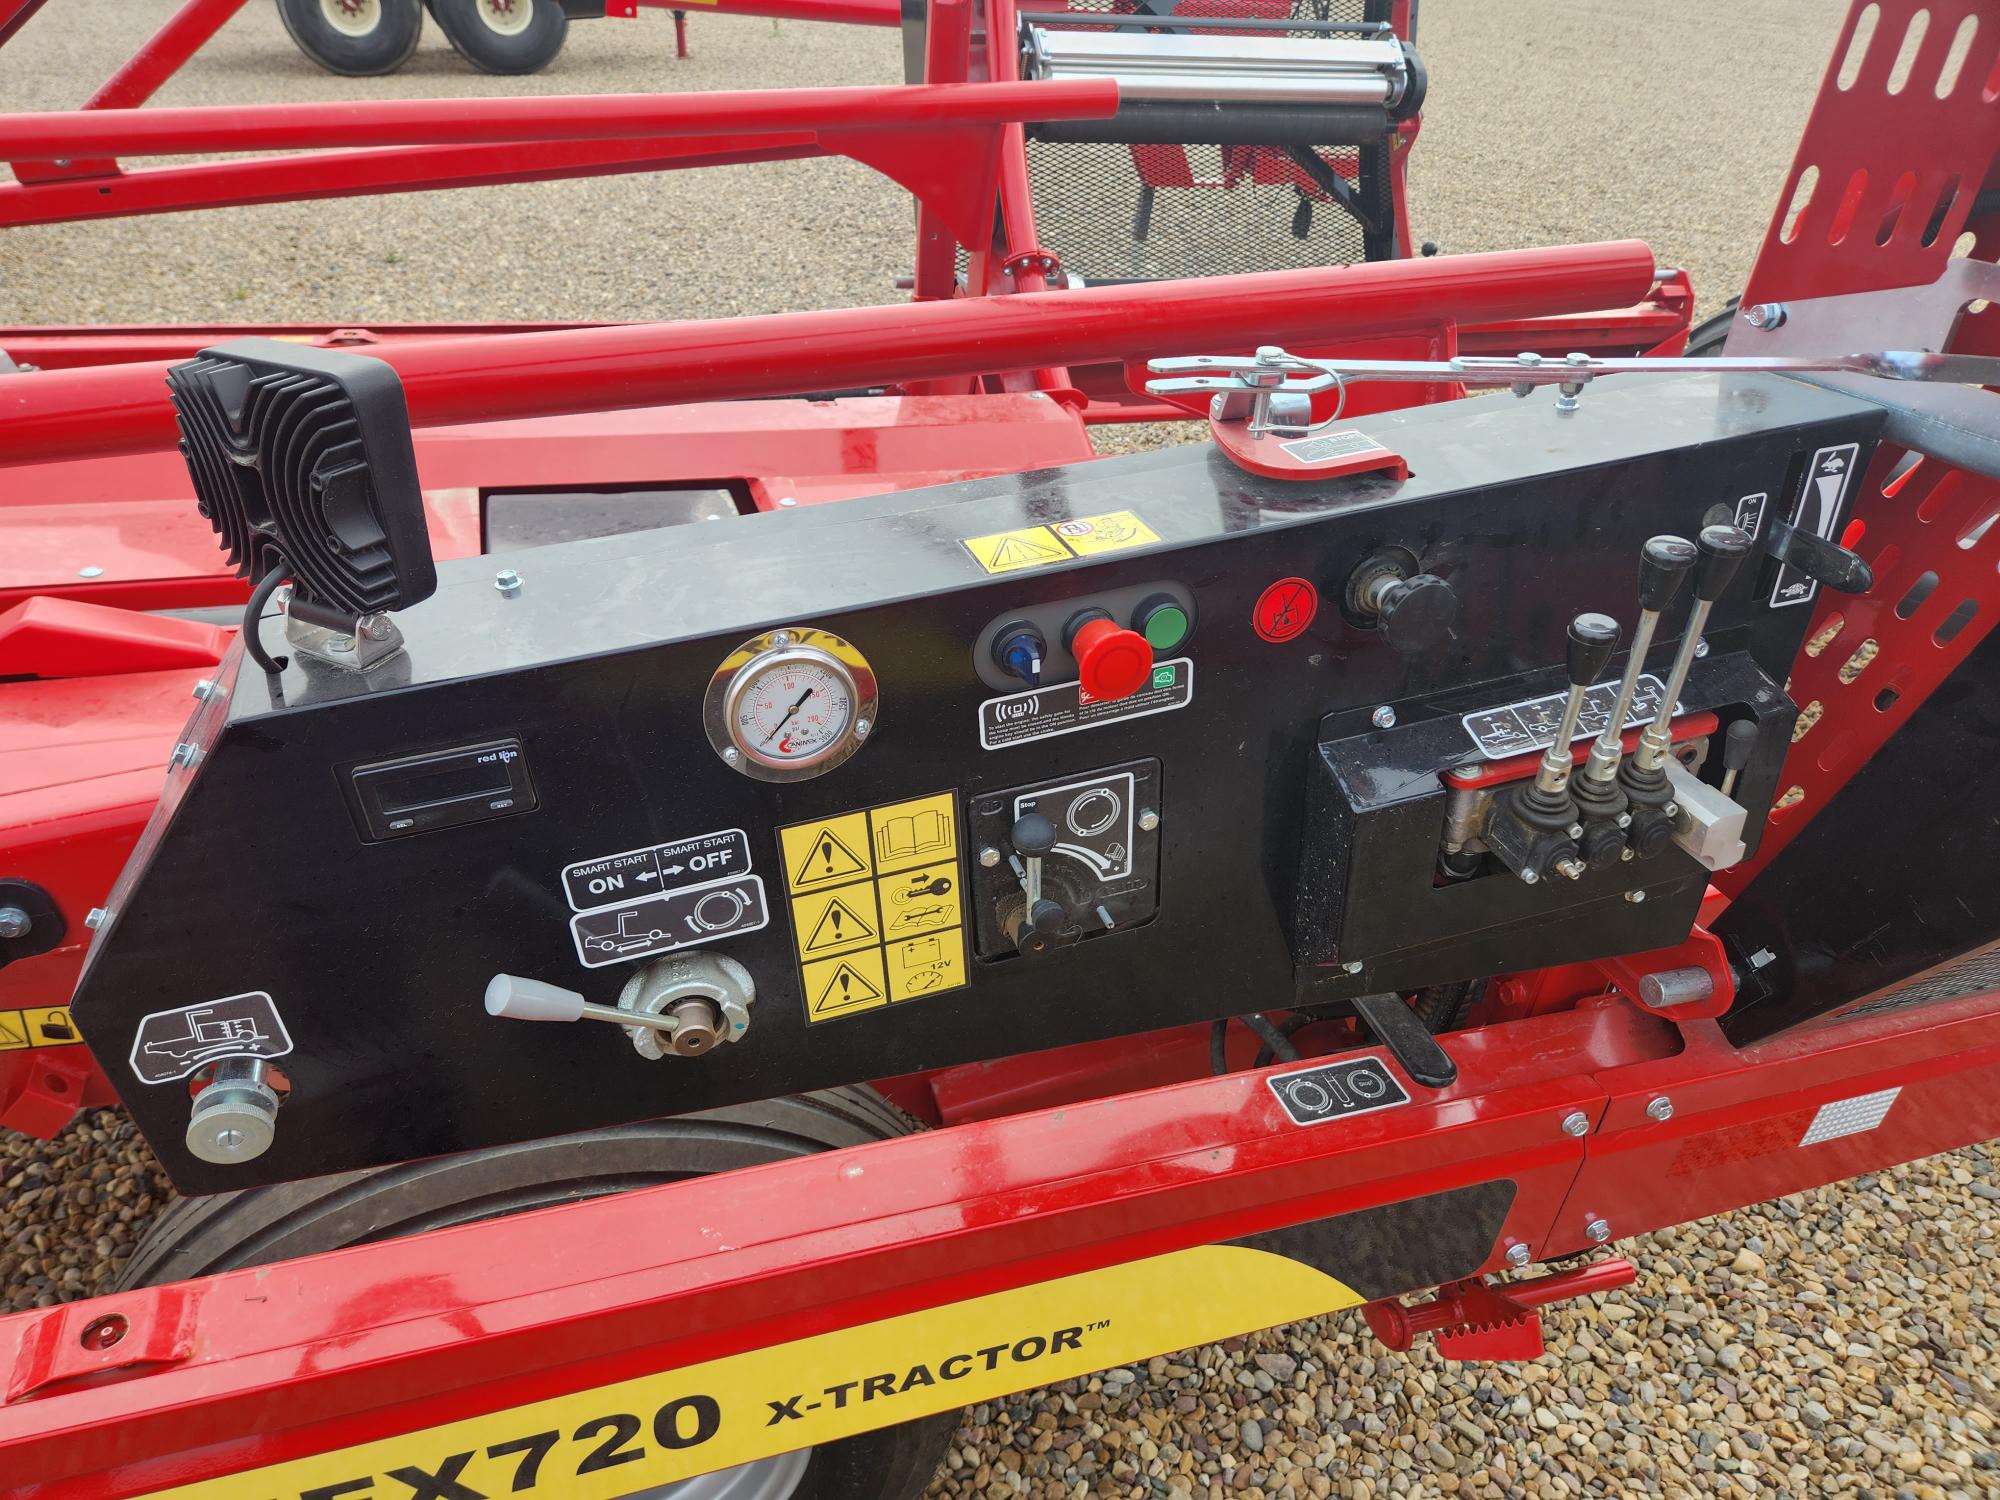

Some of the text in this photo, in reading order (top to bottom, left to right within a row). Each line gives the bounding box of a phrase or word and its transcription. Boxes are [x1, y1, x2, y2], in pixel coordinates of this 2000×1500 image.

[784, 682, 795, 691] 100
[764, 702, 773, 710] 50
[477, 750, 518, 764] red lion
[1020, 801, 1036, 809] Stop
[663, 834, 737, 858] SMART START
[573, 853, 648, 878] SMART START
[689, 849, 733, 872] OFF
[588, 874, 625, 895] ON
[930, 959, 952, 971] 12V
